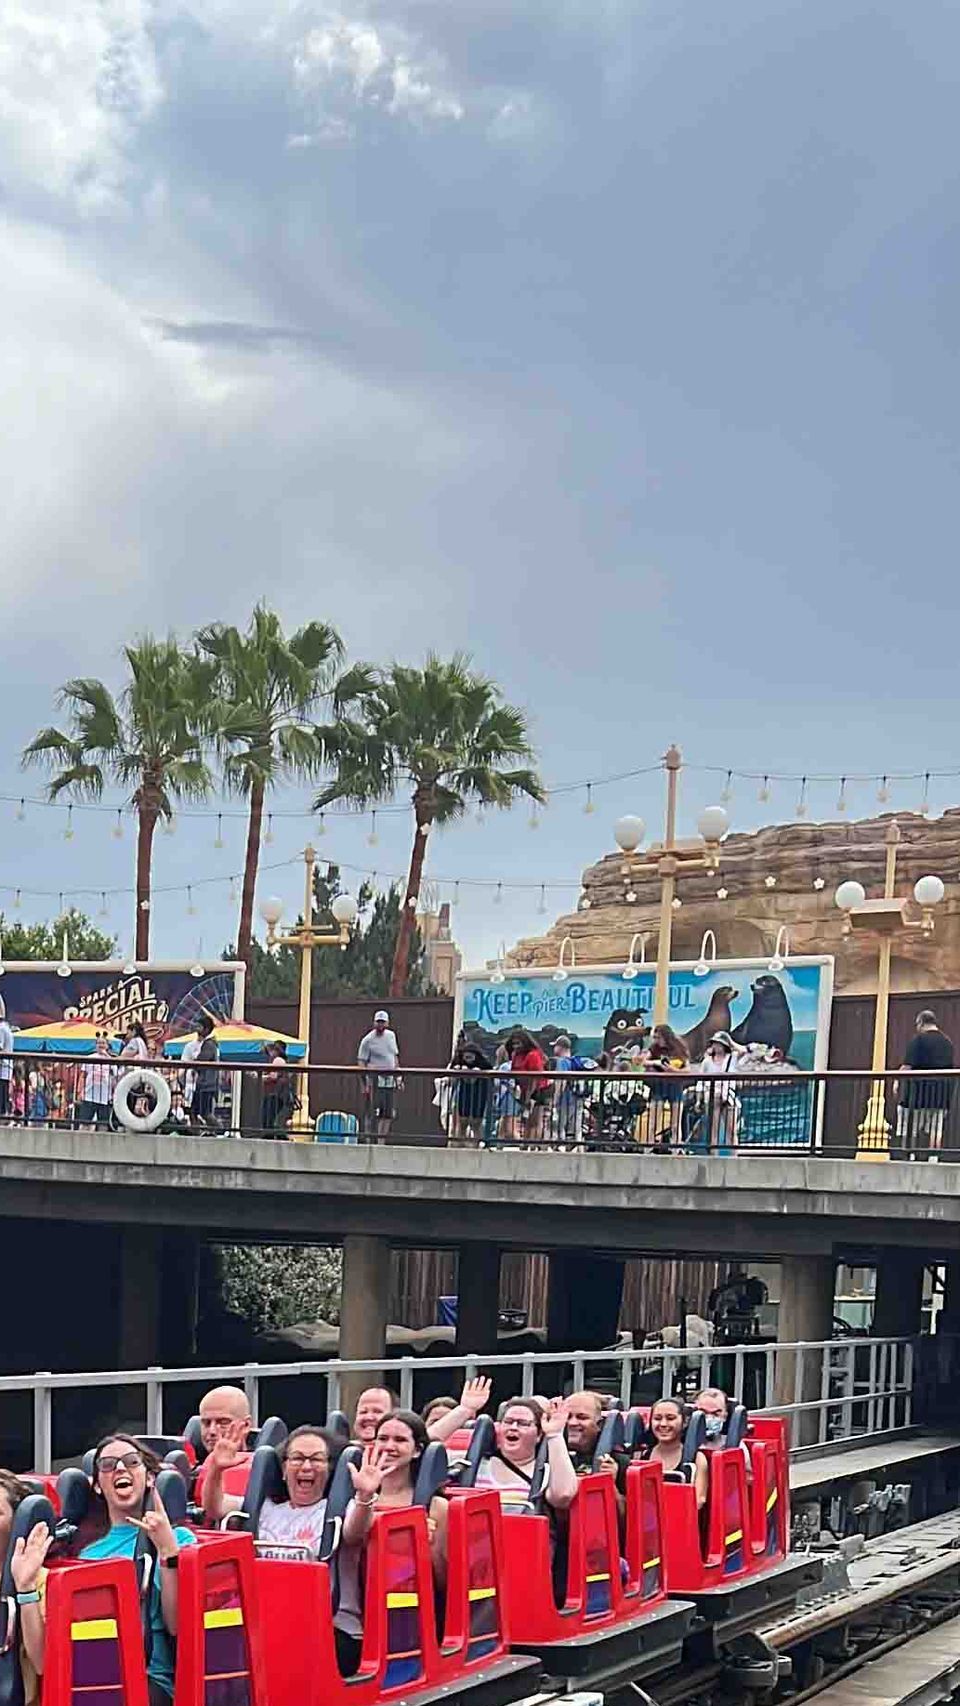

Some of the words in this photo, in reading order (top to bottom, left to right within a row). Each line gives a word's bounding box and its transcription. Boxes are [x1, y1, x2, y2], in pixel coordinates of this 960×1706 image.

[80, 984, 113, 1007] SPARK
[473, 988, 533, 1025] KEEP
[533, 997, 565, 1019] PIER
[566, 982, 696, 1013] BEAUTIUL
